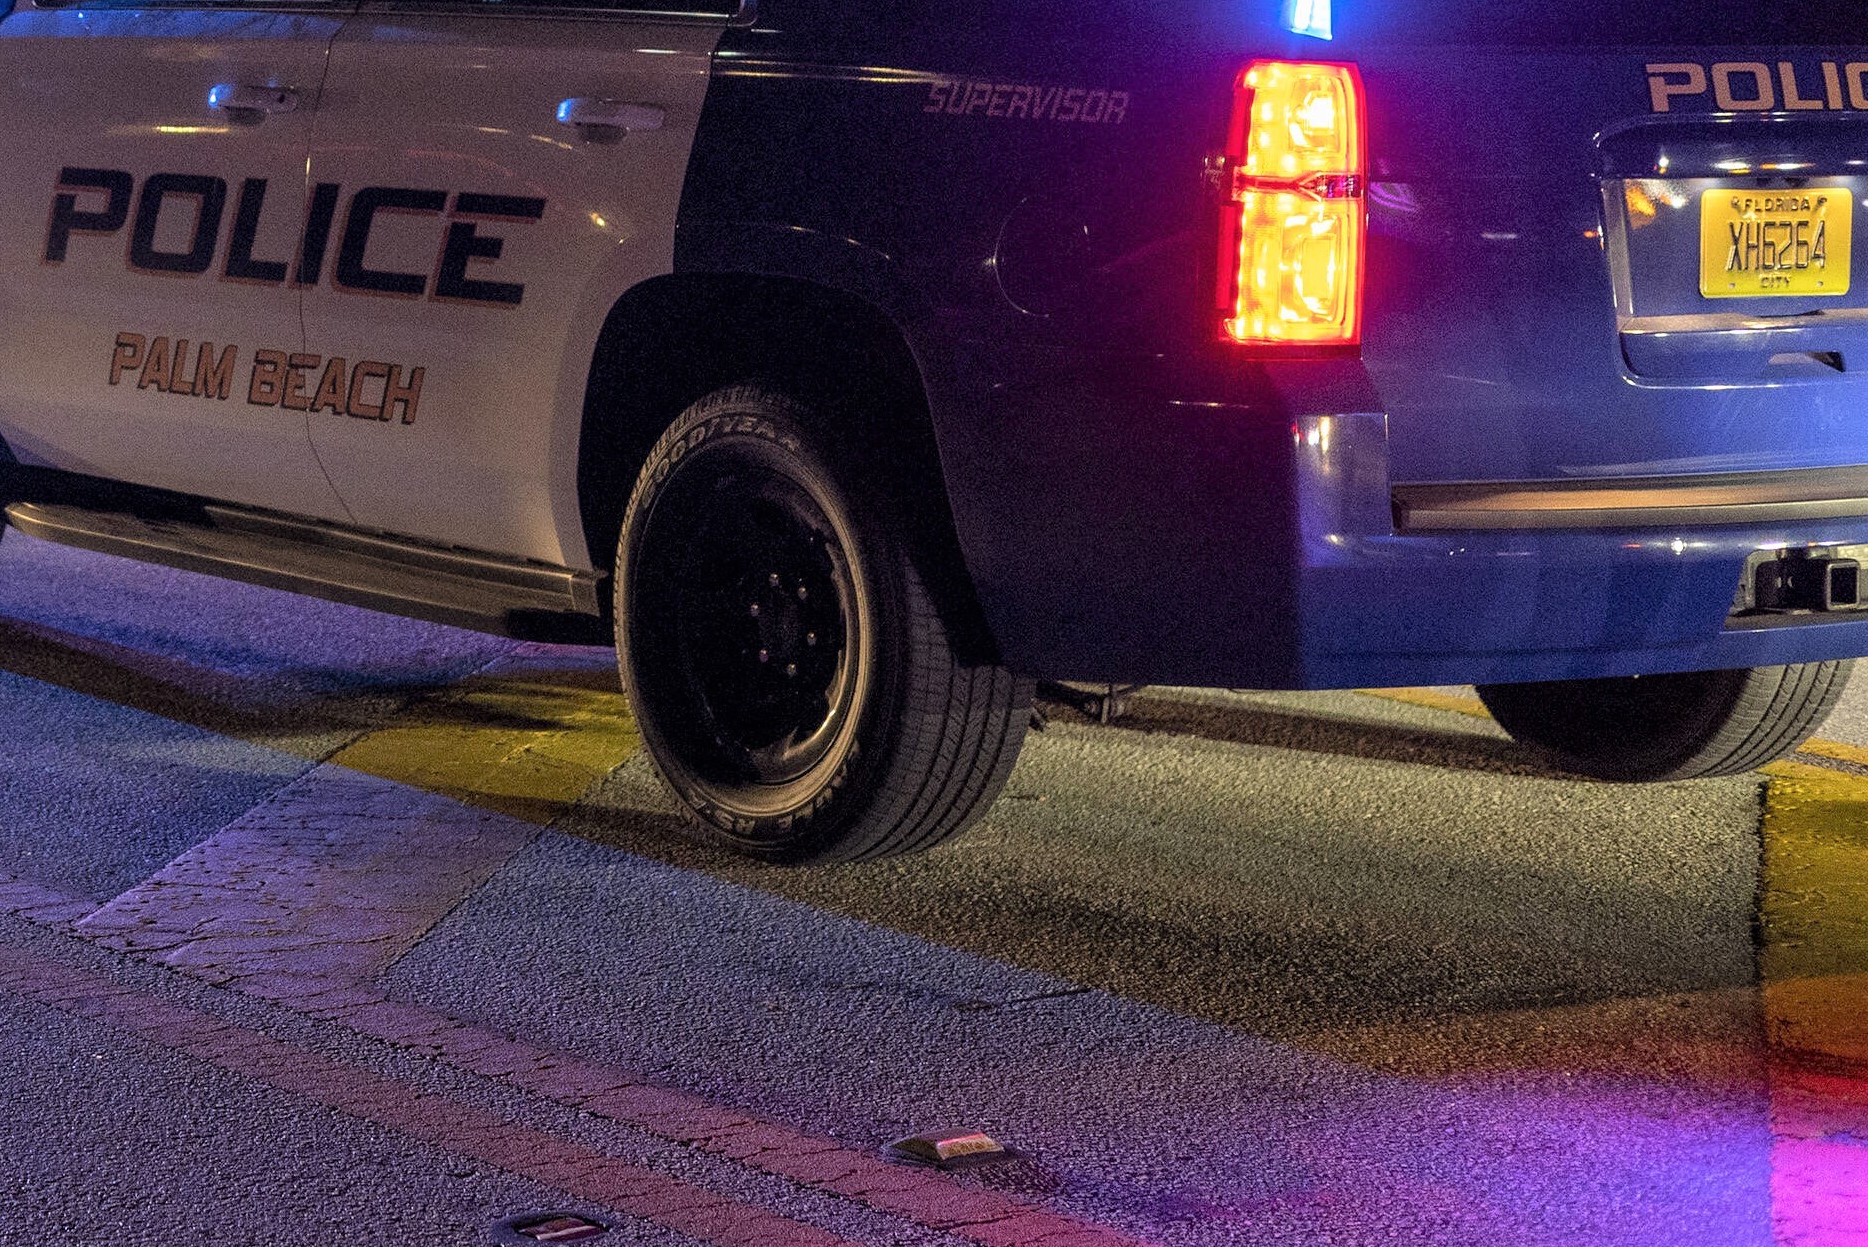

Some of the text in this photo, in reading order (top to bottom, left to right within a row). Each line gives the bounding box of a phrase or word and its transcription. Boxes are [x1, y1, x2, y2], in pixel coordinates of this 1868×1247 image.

[922, 80, 1130, 124] SUPERVISOR
[1744, 197, 1811, 212] FLORIDA
[40, 166, 546, 309] POLICE
[1725, 220, 1826, 271] XH6264
[1760, 276, 1791, 288] CITY
[108, 331, 426, 426] PALM BEACH
